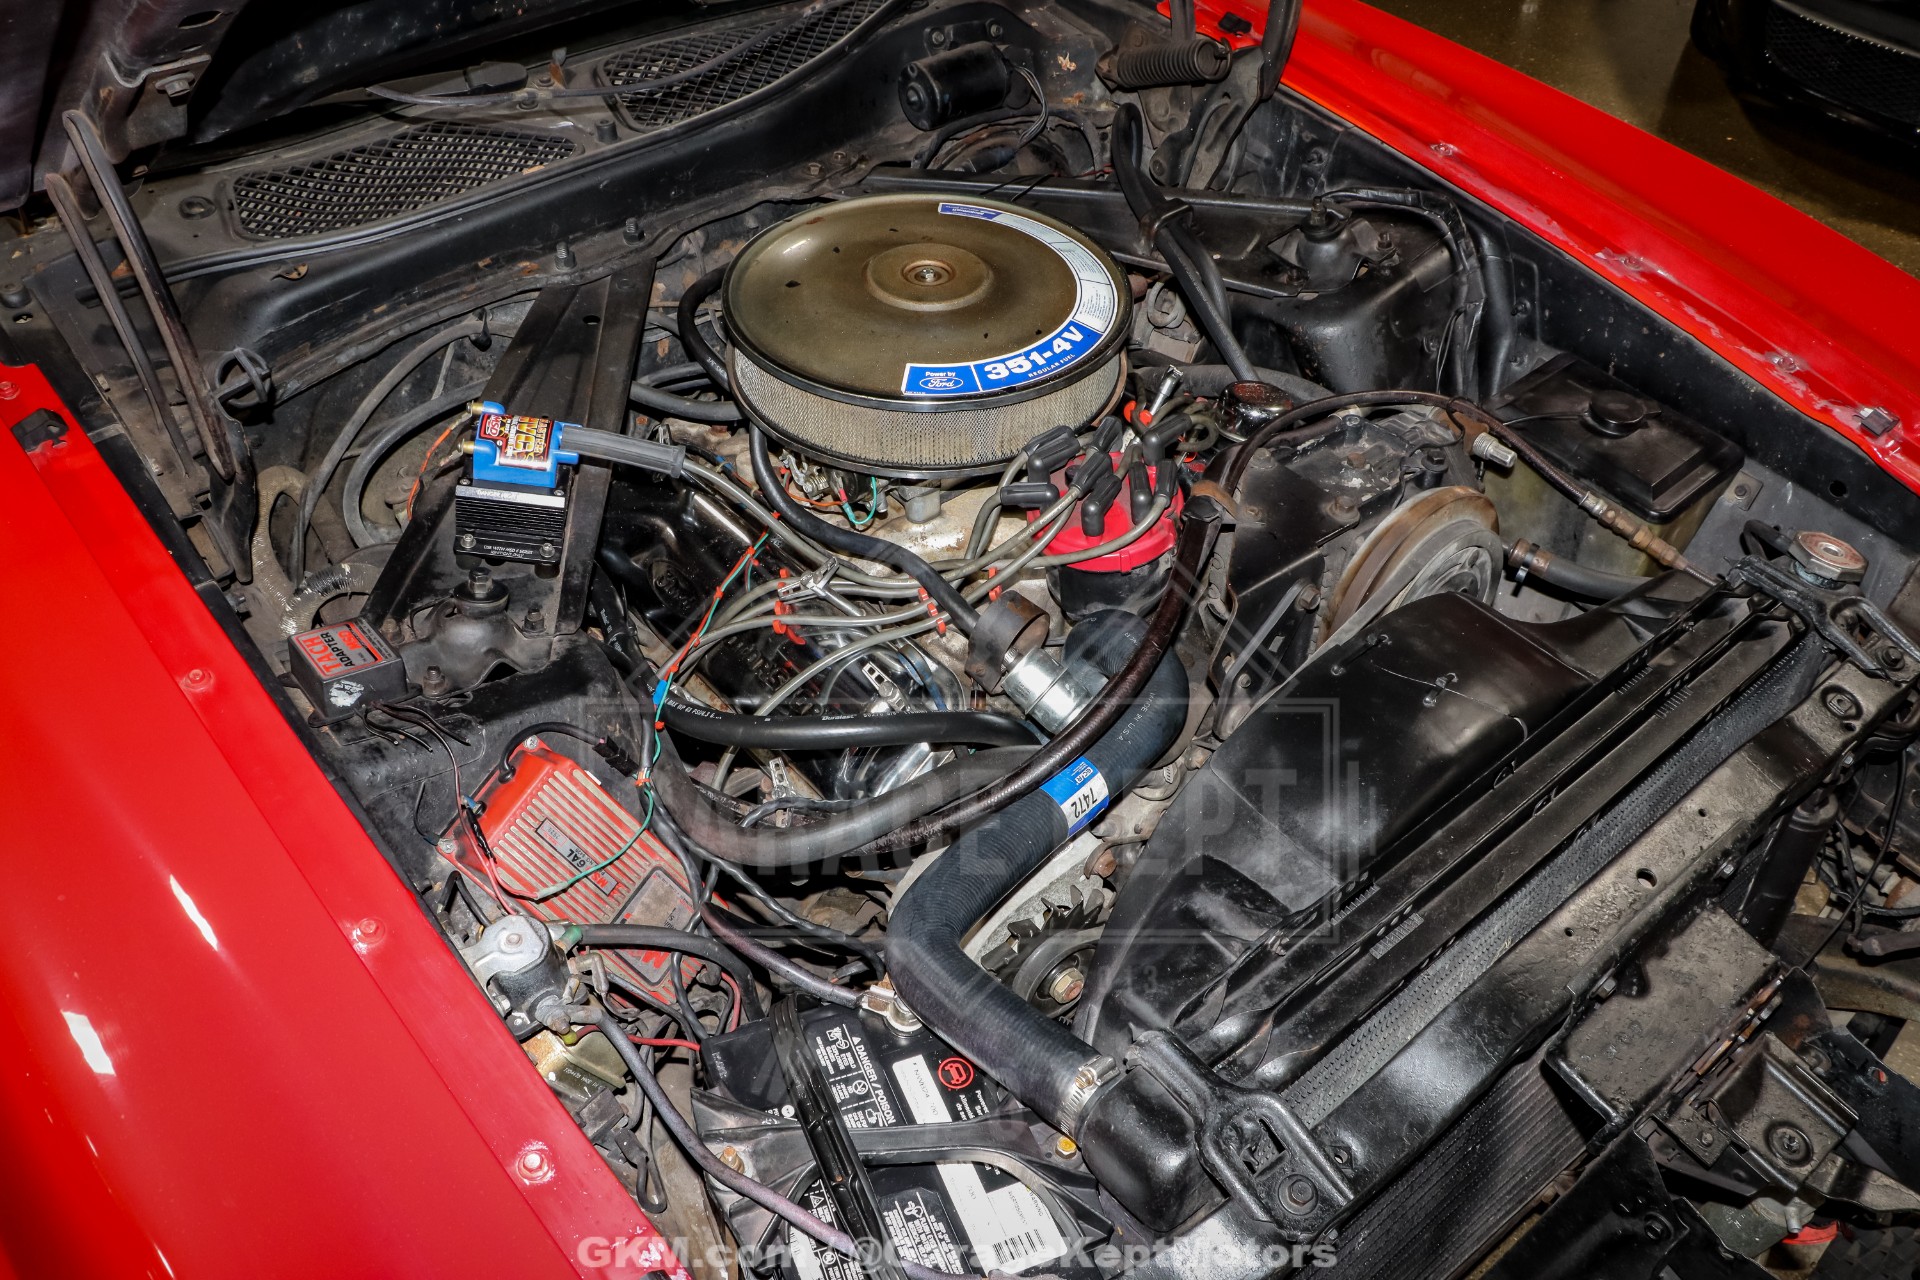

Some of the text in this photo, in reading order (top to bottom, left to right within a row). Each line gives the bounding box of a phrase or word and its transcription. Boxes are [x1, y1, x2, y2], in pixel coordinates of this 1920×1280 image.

[983, 324, 1085, 380] 351-4V
[1028, 353, 1075, 378] REGULAR FUEL
[927, 378, 956, 387] Ford
[491, 415, 501, 436] MSD
[320, 632, 355, 667] ADAPTER
[338, 630, 363, 651] MSD
[302, 636, 343, 672] TACH
[1070, 786, 1098, 819] 7472
[565, 848, 587, 870] 6AL
[854, 1044, 878, 1082] DANGER
[874, 1088, 897, 1125] POISON
[955, 1102, 963, 1112] de
